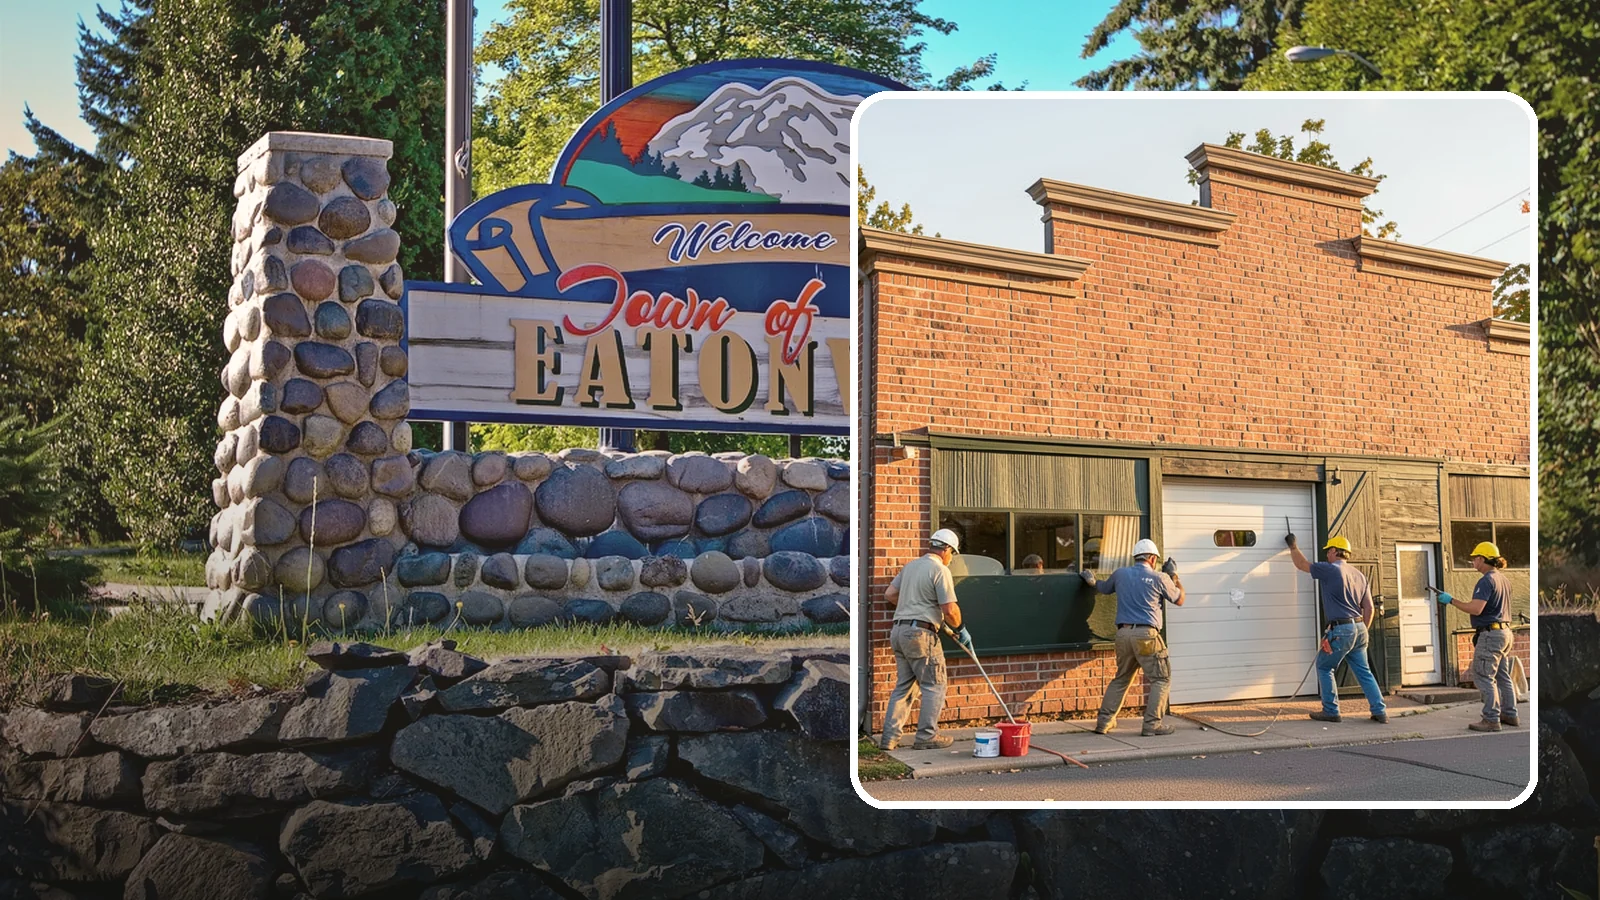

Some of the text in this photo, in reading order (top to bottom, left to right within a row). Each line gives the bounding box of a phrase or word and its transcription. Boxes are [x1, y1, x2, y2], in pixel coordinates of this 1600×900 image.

[654, 221, 836, 262] Welcome
[557, 264, 825, 364] Town of
